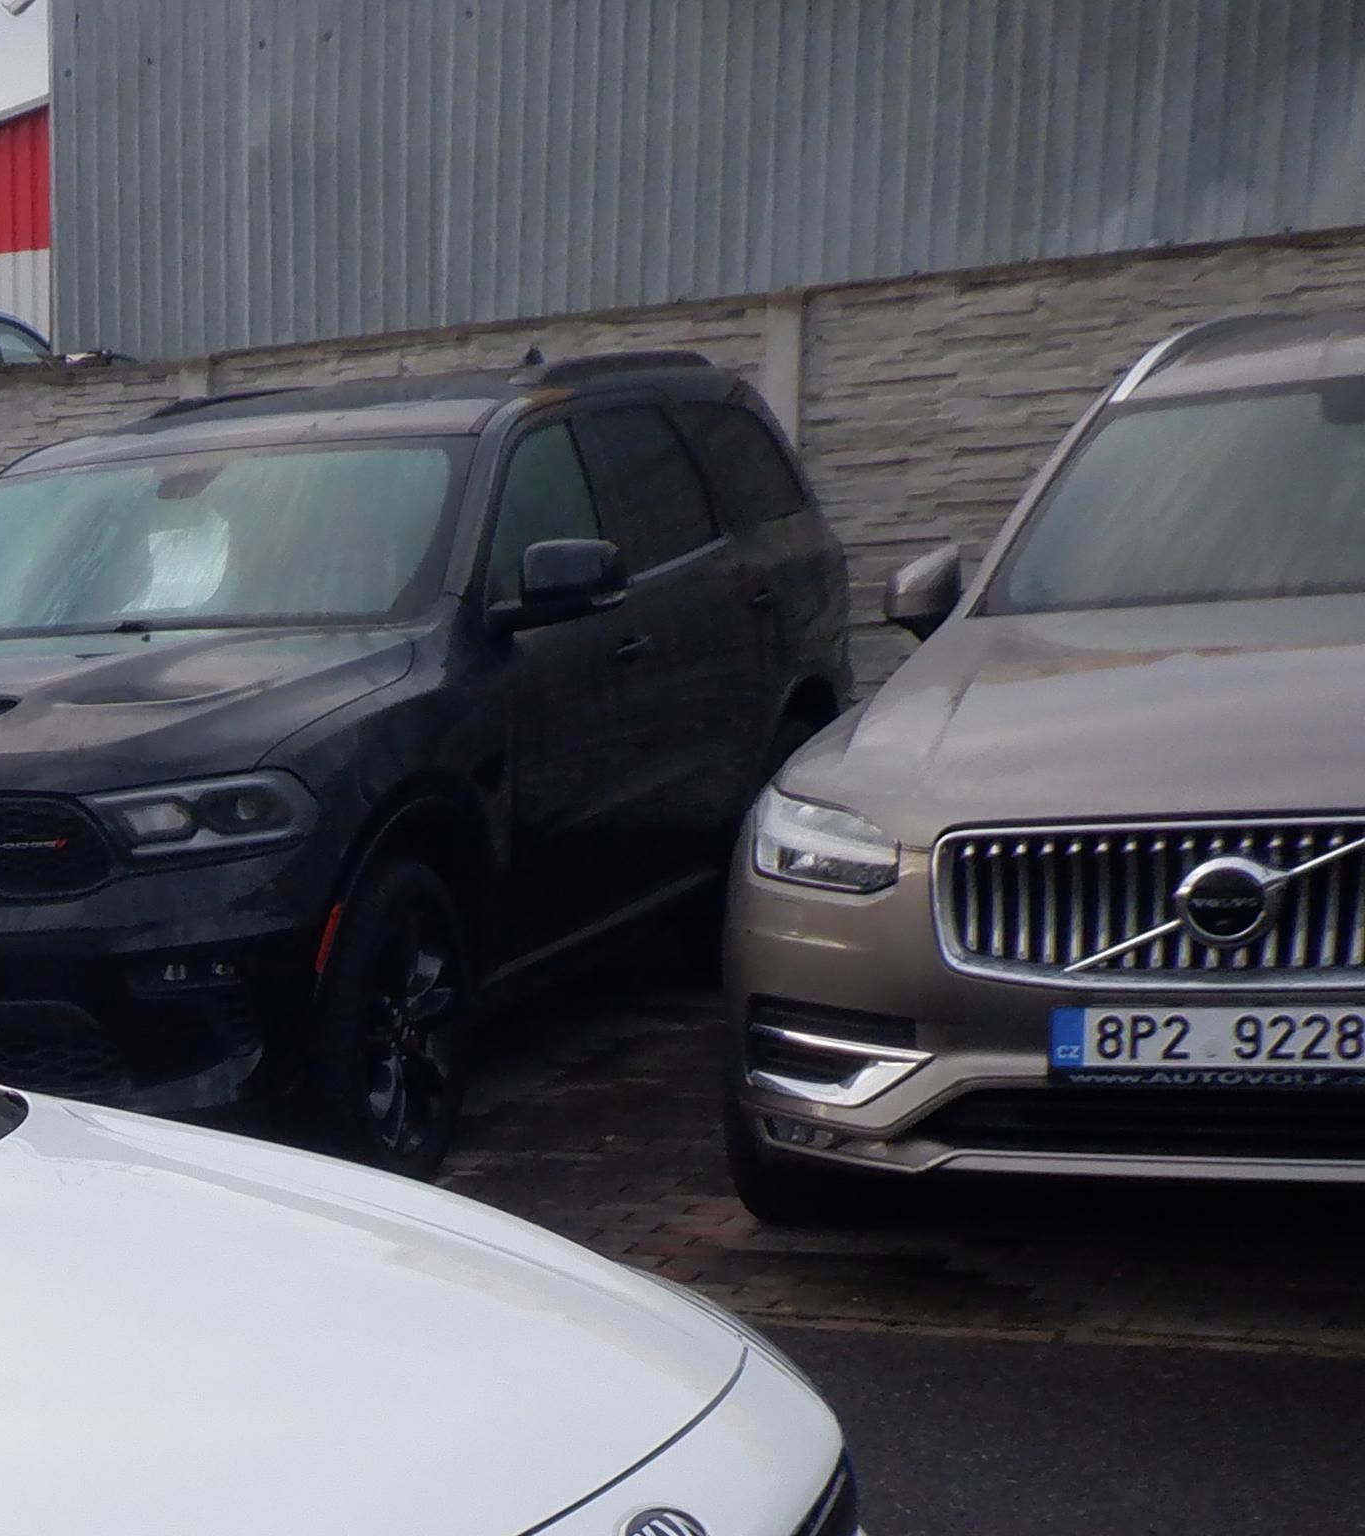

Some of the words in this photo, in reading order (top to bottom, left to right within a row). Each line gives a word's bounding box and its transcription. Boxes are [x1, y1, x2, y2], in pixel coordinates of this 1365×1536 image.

[1056, 1045, 1082, 1060] CZ
[1096, 1014, 1191, 1061] 8P2
[1233, 1013, 1365, 1061] 9228
